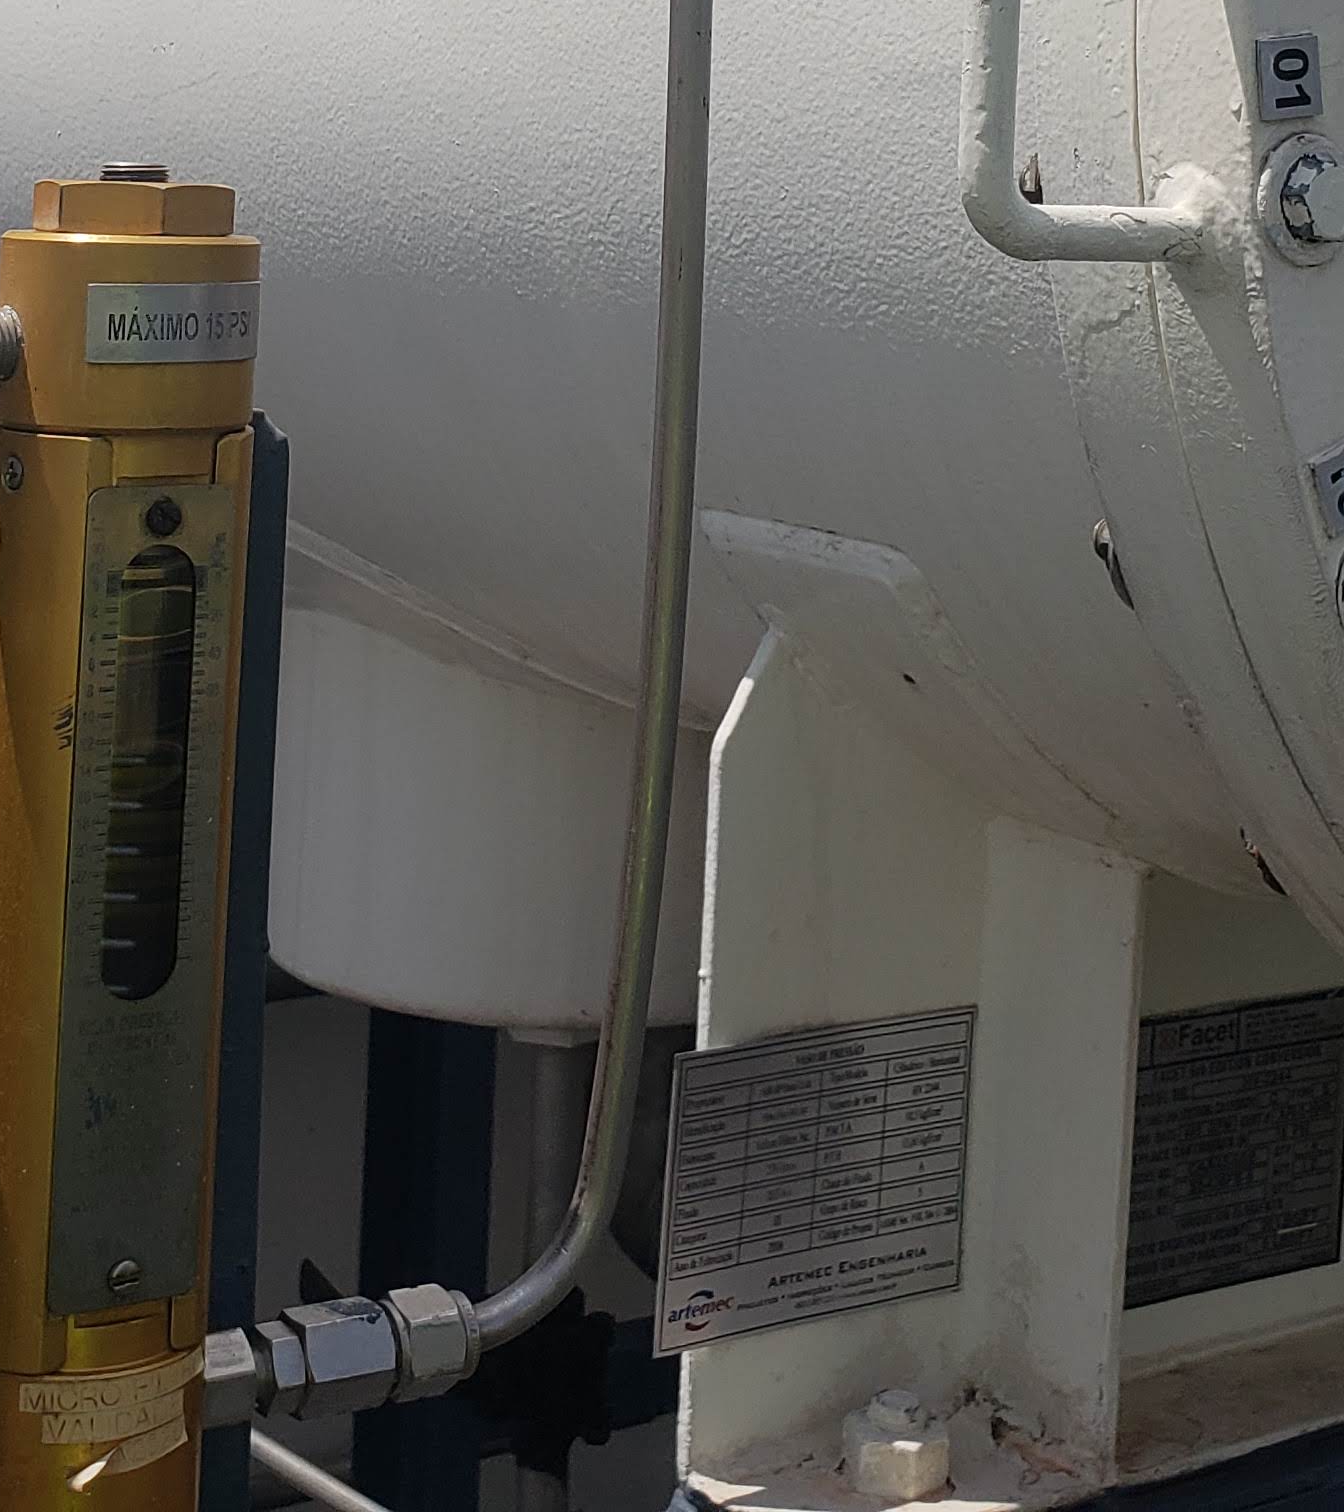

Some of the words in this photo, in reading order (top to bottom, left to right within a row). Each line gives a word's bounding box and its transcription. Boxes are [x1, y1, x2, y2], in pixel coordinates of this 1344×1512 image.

[1272, 48, 1311, 110] 01
[108, 306, 199, 342] MÁXIMO
[767, 1265, 833, 1289] ARTEMEC
[838, 1246, 927, 1274] ENGENHARIA
[667, 1296, 736, 1324] artemec
